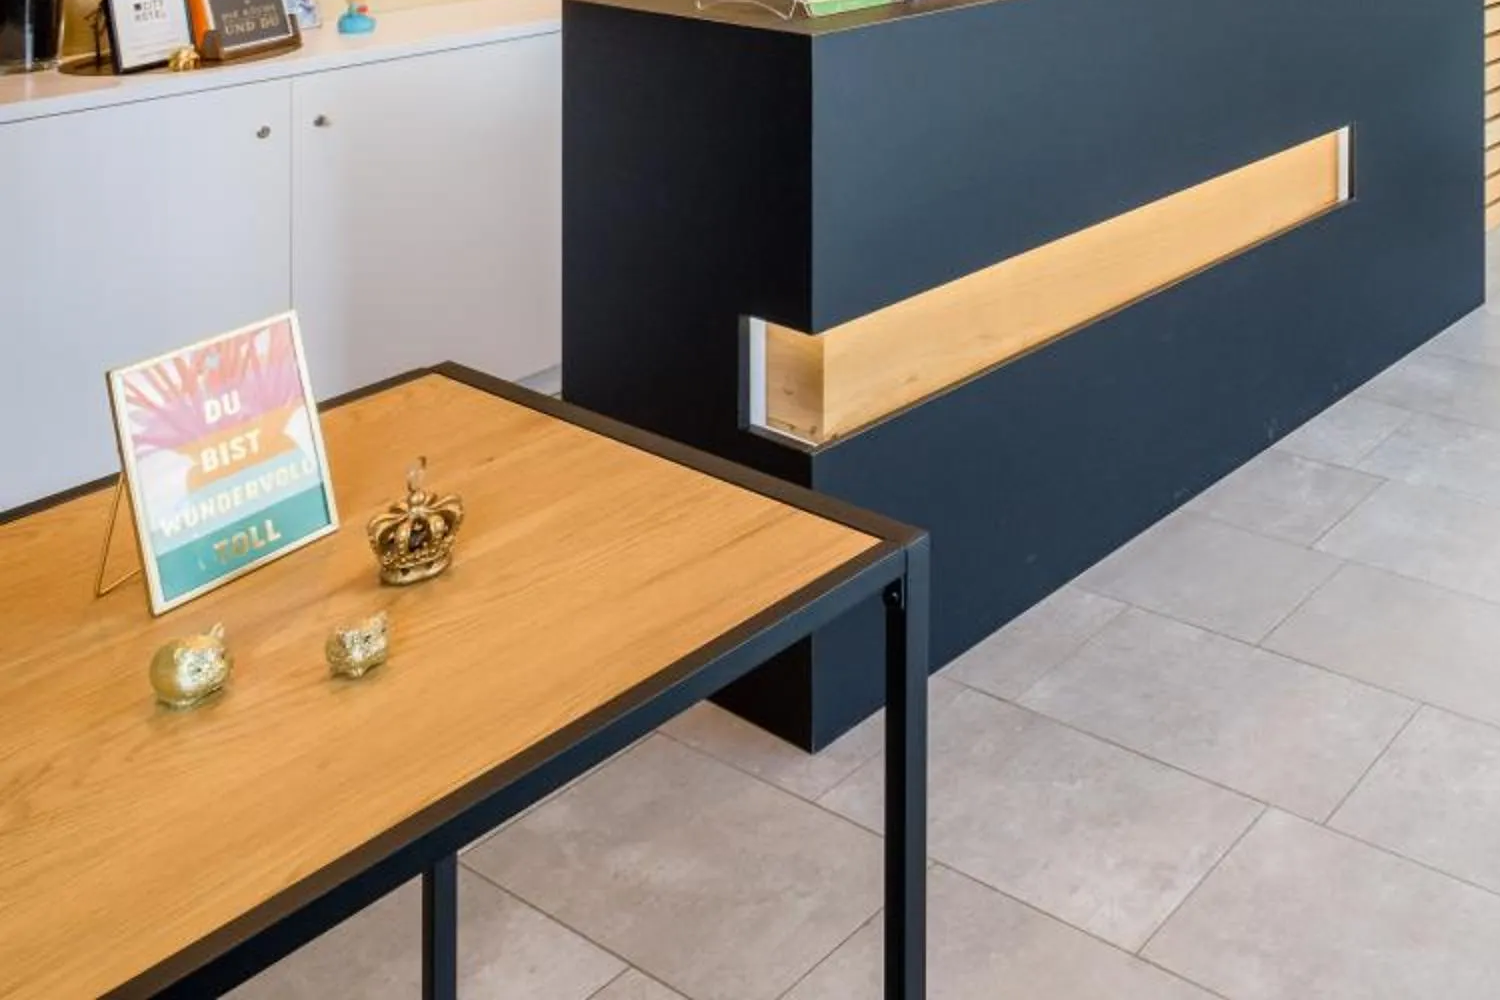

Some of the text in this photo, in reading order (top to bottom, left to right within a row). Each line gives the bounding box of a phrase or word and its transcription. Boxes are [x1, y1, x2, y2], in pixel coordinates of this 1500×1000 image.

[204, 390, 241, 424] DU
[201, 429, 261, 473] BIST
[213, 518, 281, 564] TOLL
